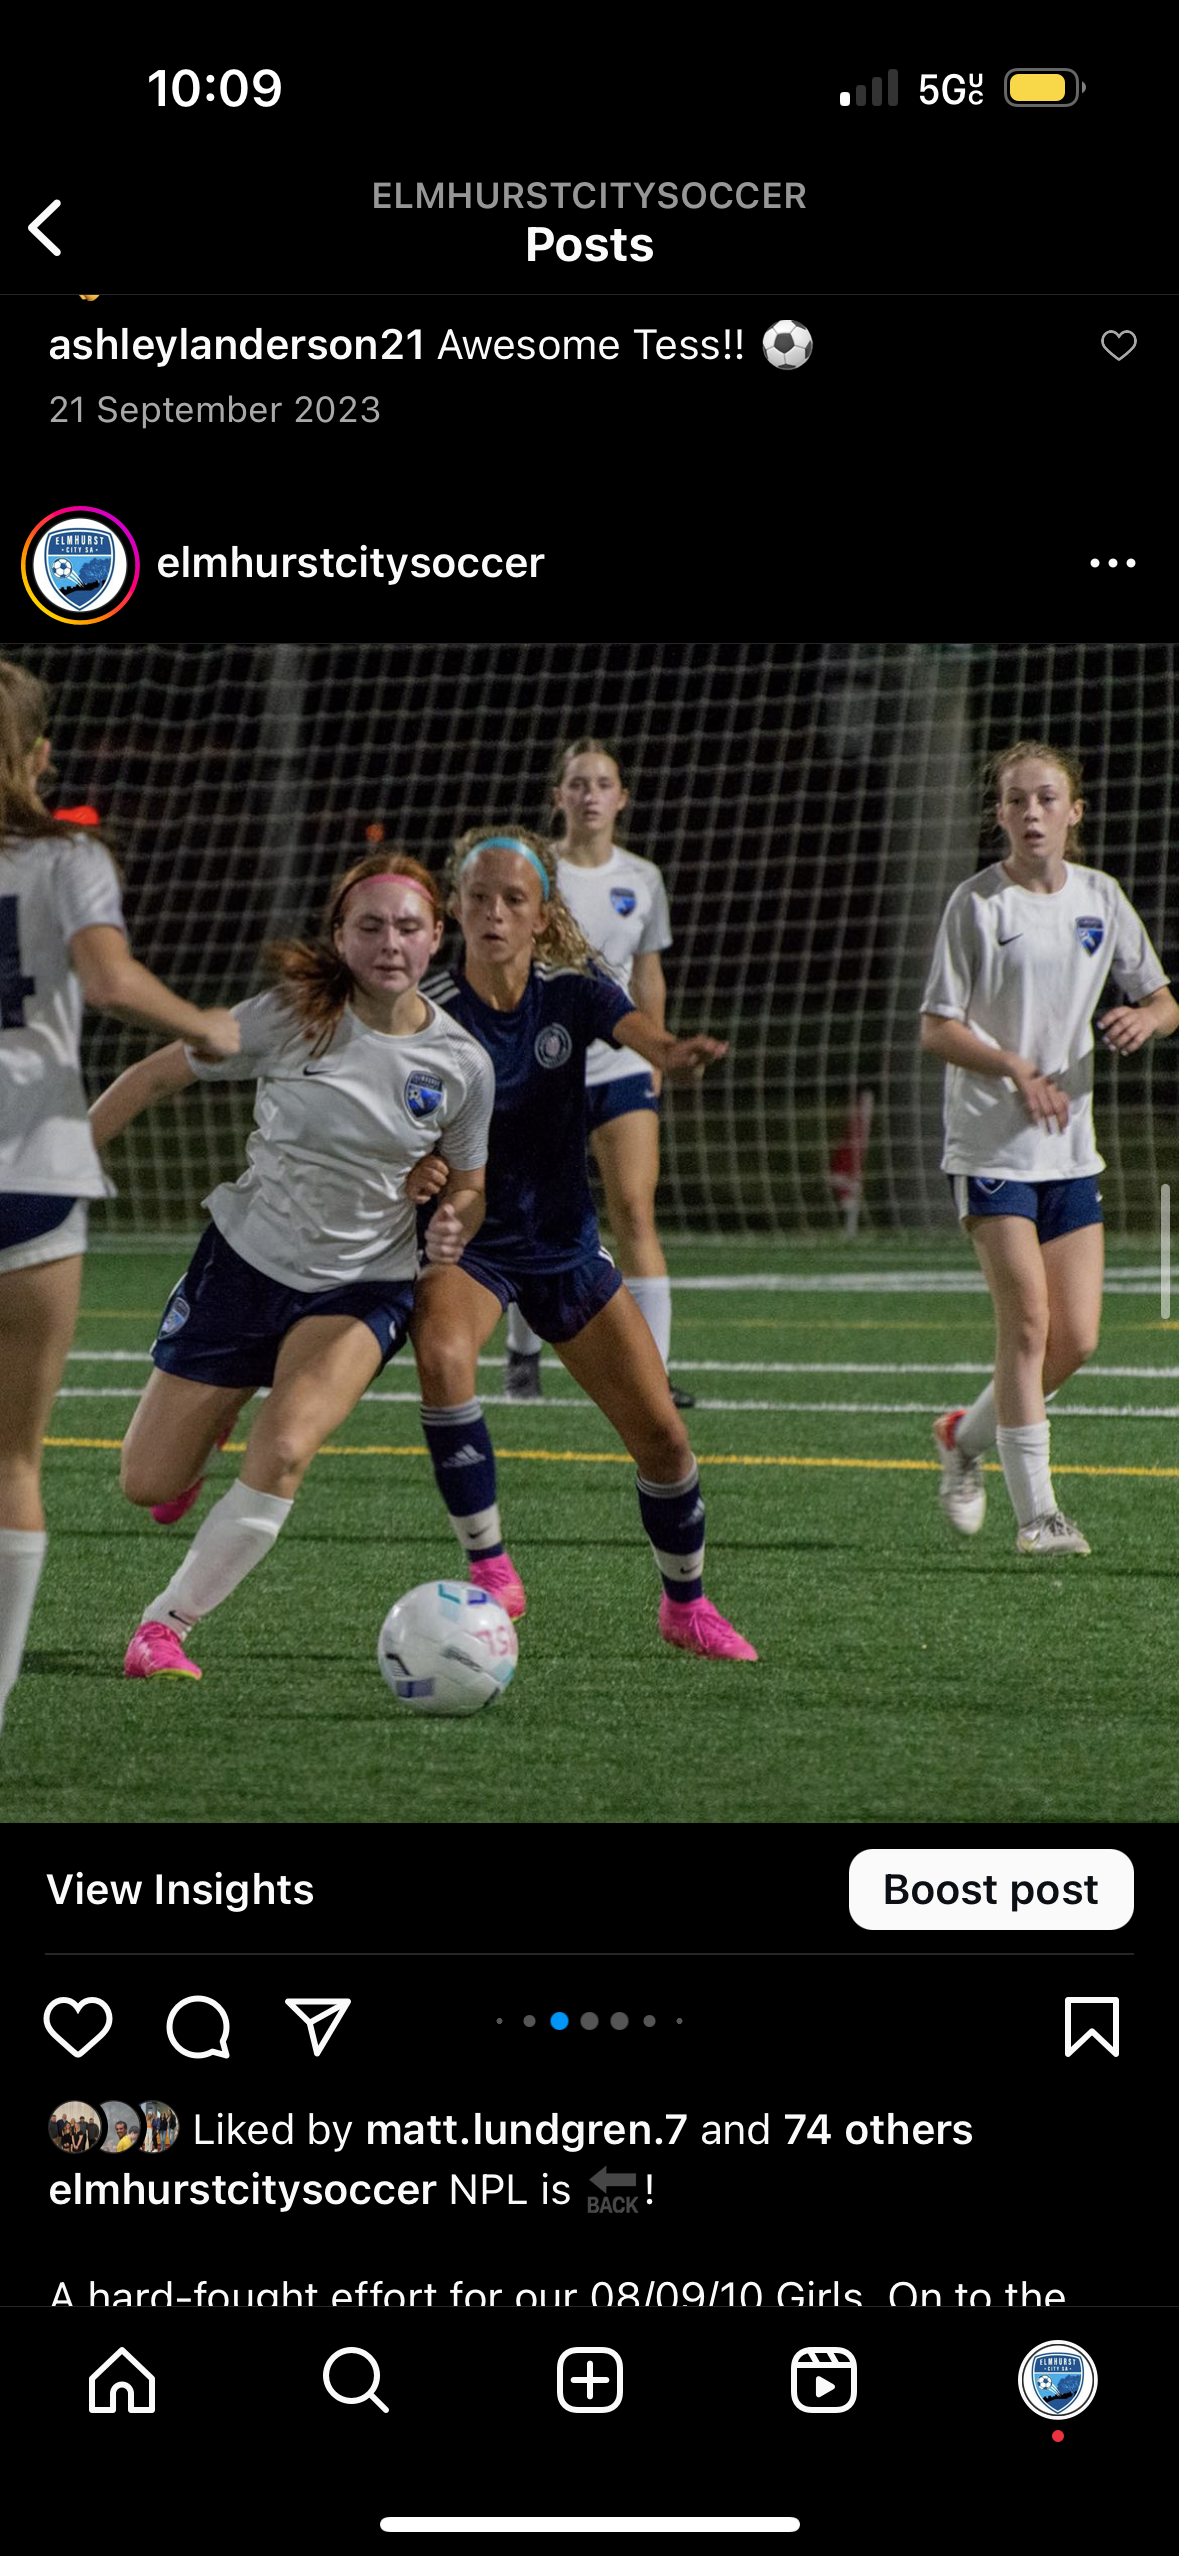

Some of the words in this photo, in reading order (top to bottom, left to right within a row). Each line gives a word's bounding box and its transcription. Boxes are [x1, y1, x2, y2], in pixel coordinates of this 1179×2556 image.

[149, 69, 281, 107] 10:09
[373, 181, 807, 210] ELMHURSTCITYSOCCER
[527, 226, 654, 263] Posts
[49, 328, 422, 367] ashleylanderson21
[437, 329, 620, 361] Awesome
[633, 329, 744, 361] Tess!!
[50, 395, 82, 423] 21
[97, 394, 283, 430] September
[295, 395, 380, 424] 2023
[55, 535, 104, 545] ELMHURST
[157, 545, 546, 586] elmhurstcitysoccer
[45, 1872, 143, 1905] View
[155, 1872, 314, 1912] Insights
[886, 1873, 998, 1905] Boost
[1011, 1876, 1099, 1912] post
[194, 2113, 294, 2146] Liked
[308, 2113, 353, 2153] by
[367, 2113, 688, 2153] matt.lundgren.7
[701, 2113, 770, 2146] and
[784, 2113, 832, 2145] 74
[845, 2113, 973, 2146] others
[49, 2172, 438, 2213] elmhurstcitysoccer
[450, 2173, 528, 2205] NPL
[542, 2172, 571, 2206] is
[51, 2281, 73, 2306] A
[331, 2281, 438, 2306] effort
[449, 2281, 503, 2306] for
[515, 2289, 578, 2306] our
[888, 2281, 942, 2306] On
[954, 2283, 992, 2306] to
[1004, 2281, 1066, 2306] the
[1039, 2357, 1076, 2366] ELMHURST
